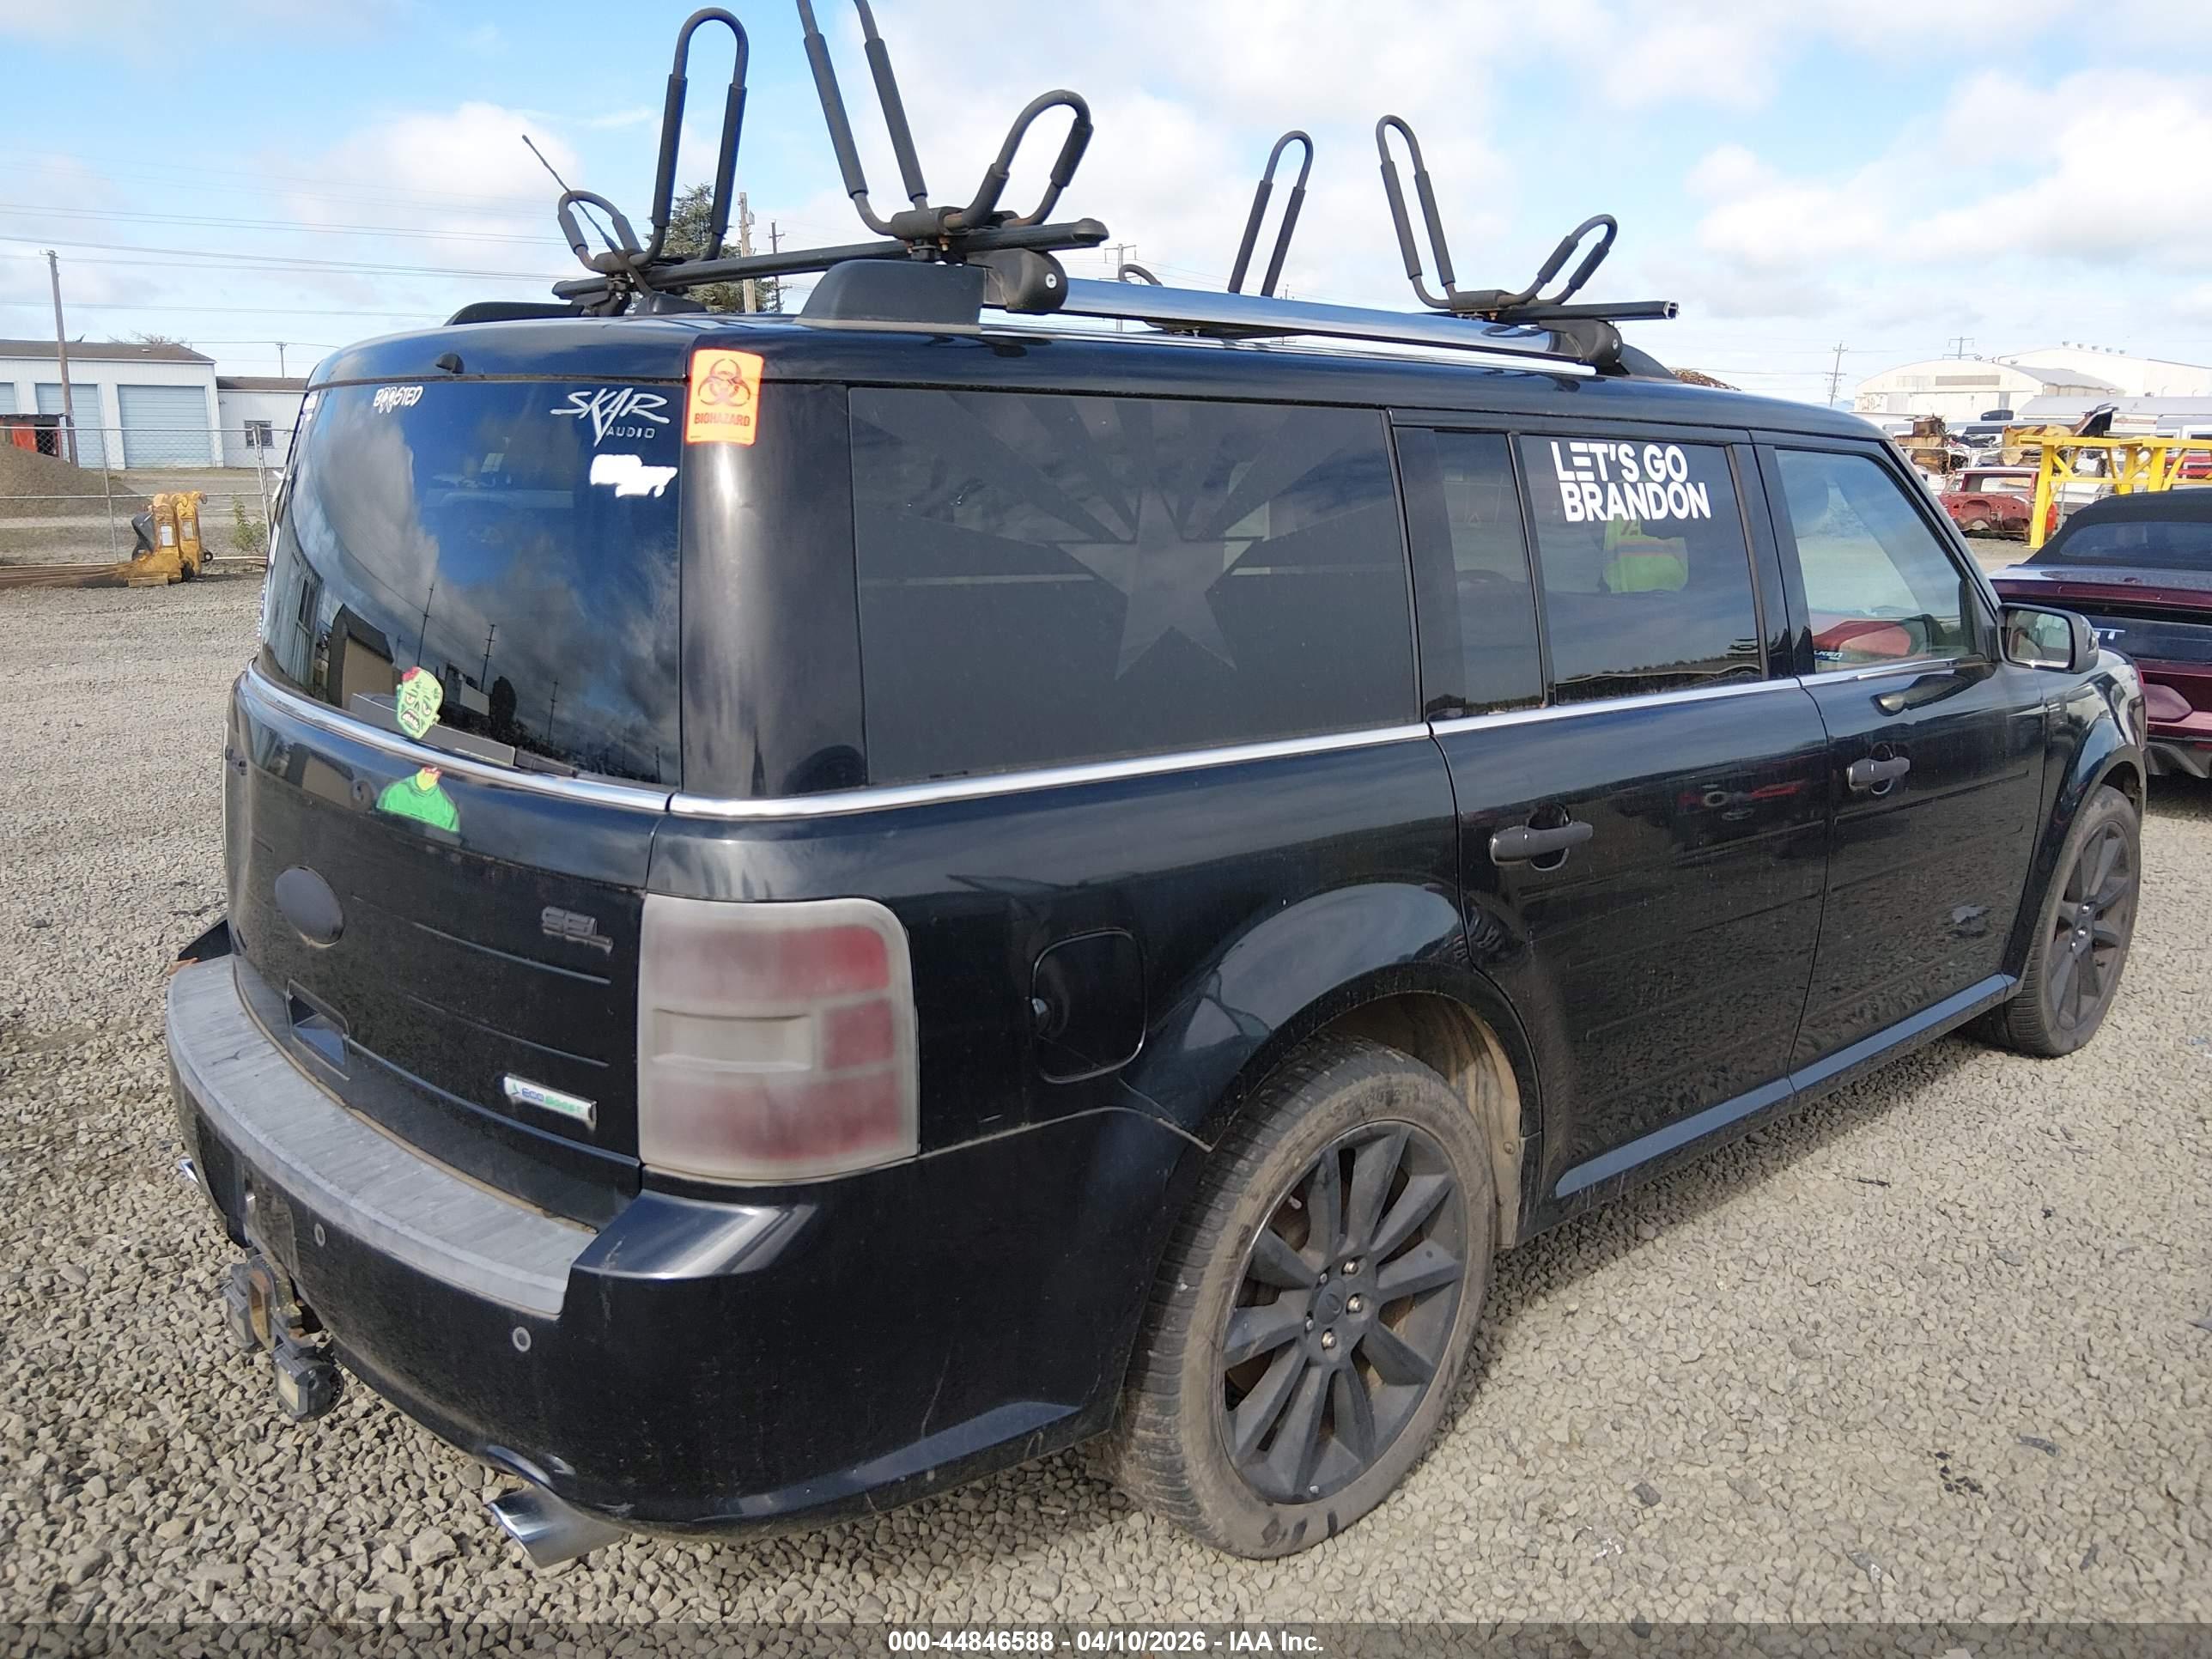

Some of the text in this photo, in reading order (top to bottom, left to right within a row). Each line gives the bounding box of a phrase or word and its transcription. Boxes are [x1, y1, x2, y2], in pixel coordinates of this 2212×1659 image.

[373, 386, 423, 414] BOOSTED
[550, 387, 670, 447] SKAR
[694, 412, 750, 427] BIOHAZARD
[605, 427, 655, 440] AUDIO
[1550, 441, 1688, 483] LET'S GO
[1559, 481, 1711, 522] BRANDON
[542, 906, 613, 953] SEL
